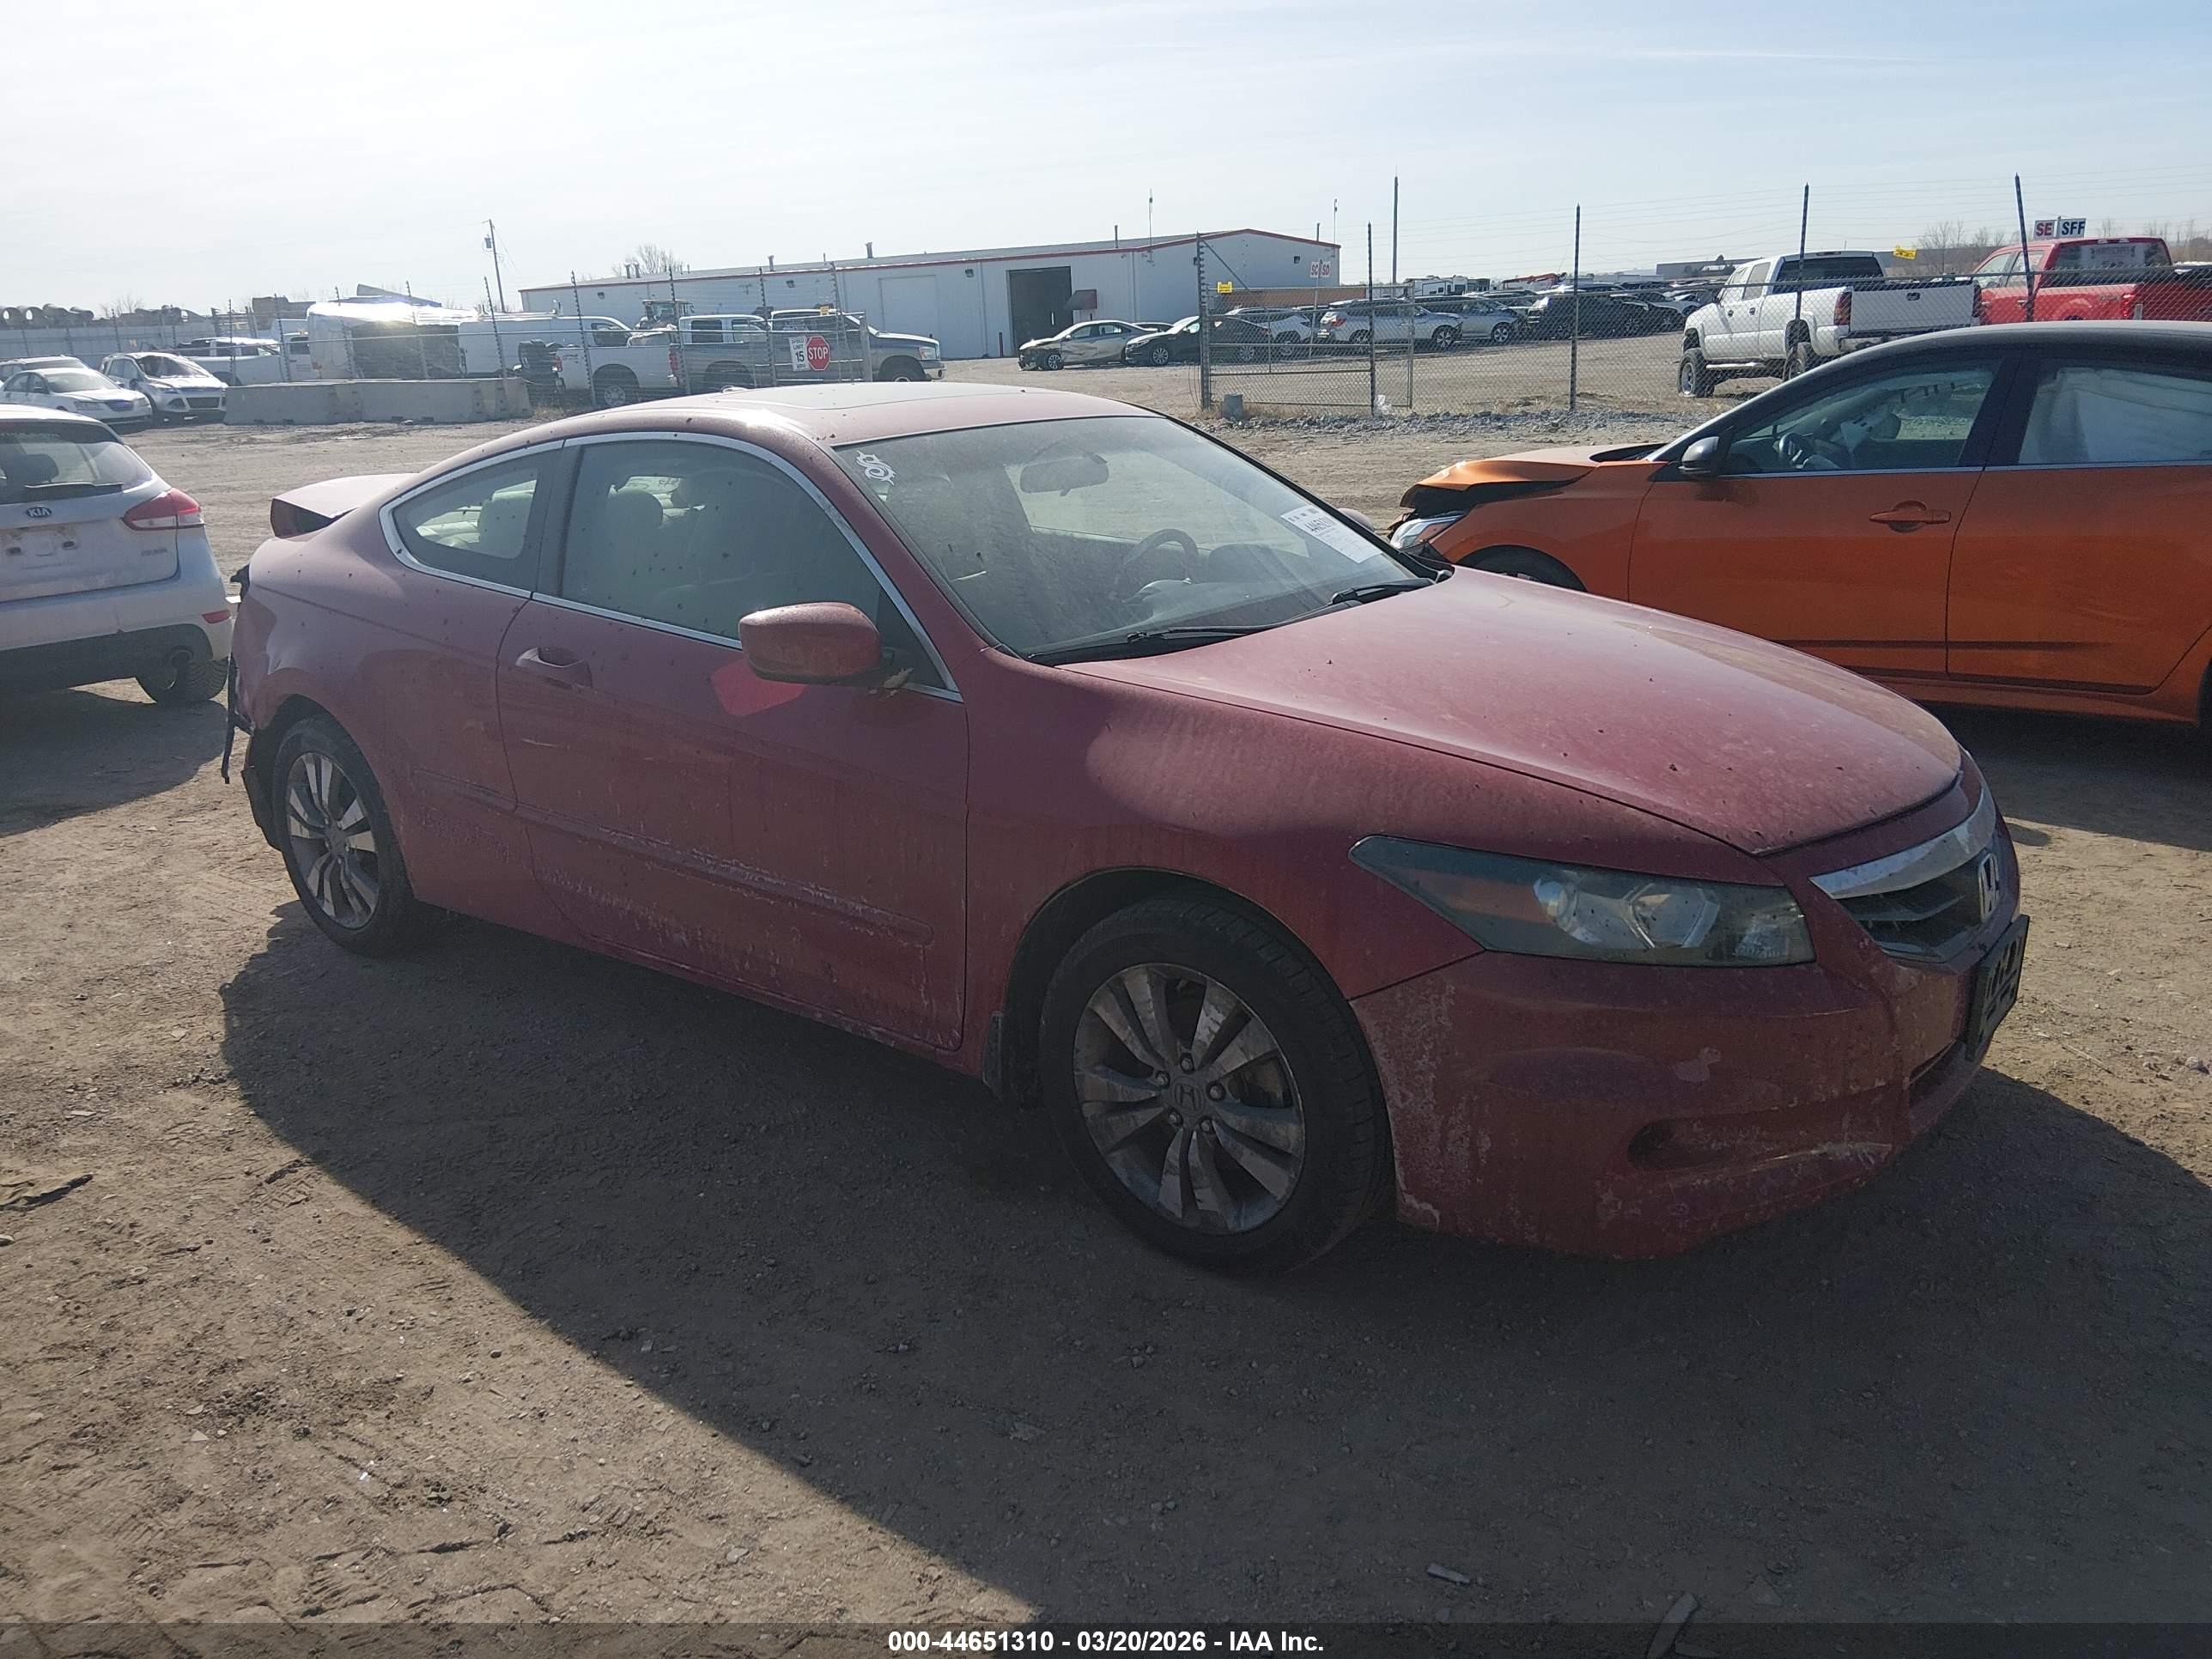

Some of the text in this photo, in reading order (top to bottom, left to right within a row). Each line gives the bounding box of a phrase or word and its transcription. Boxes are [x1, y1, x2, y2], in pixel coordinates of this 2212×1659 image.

[2036, 222, 2052, 236] SE
[2061, 221, 2086, 235] SFF
[795, 350, 805, 362] 15
[808, 346, 829, 360] STOP
[29, 507, 49, 517] KIA
